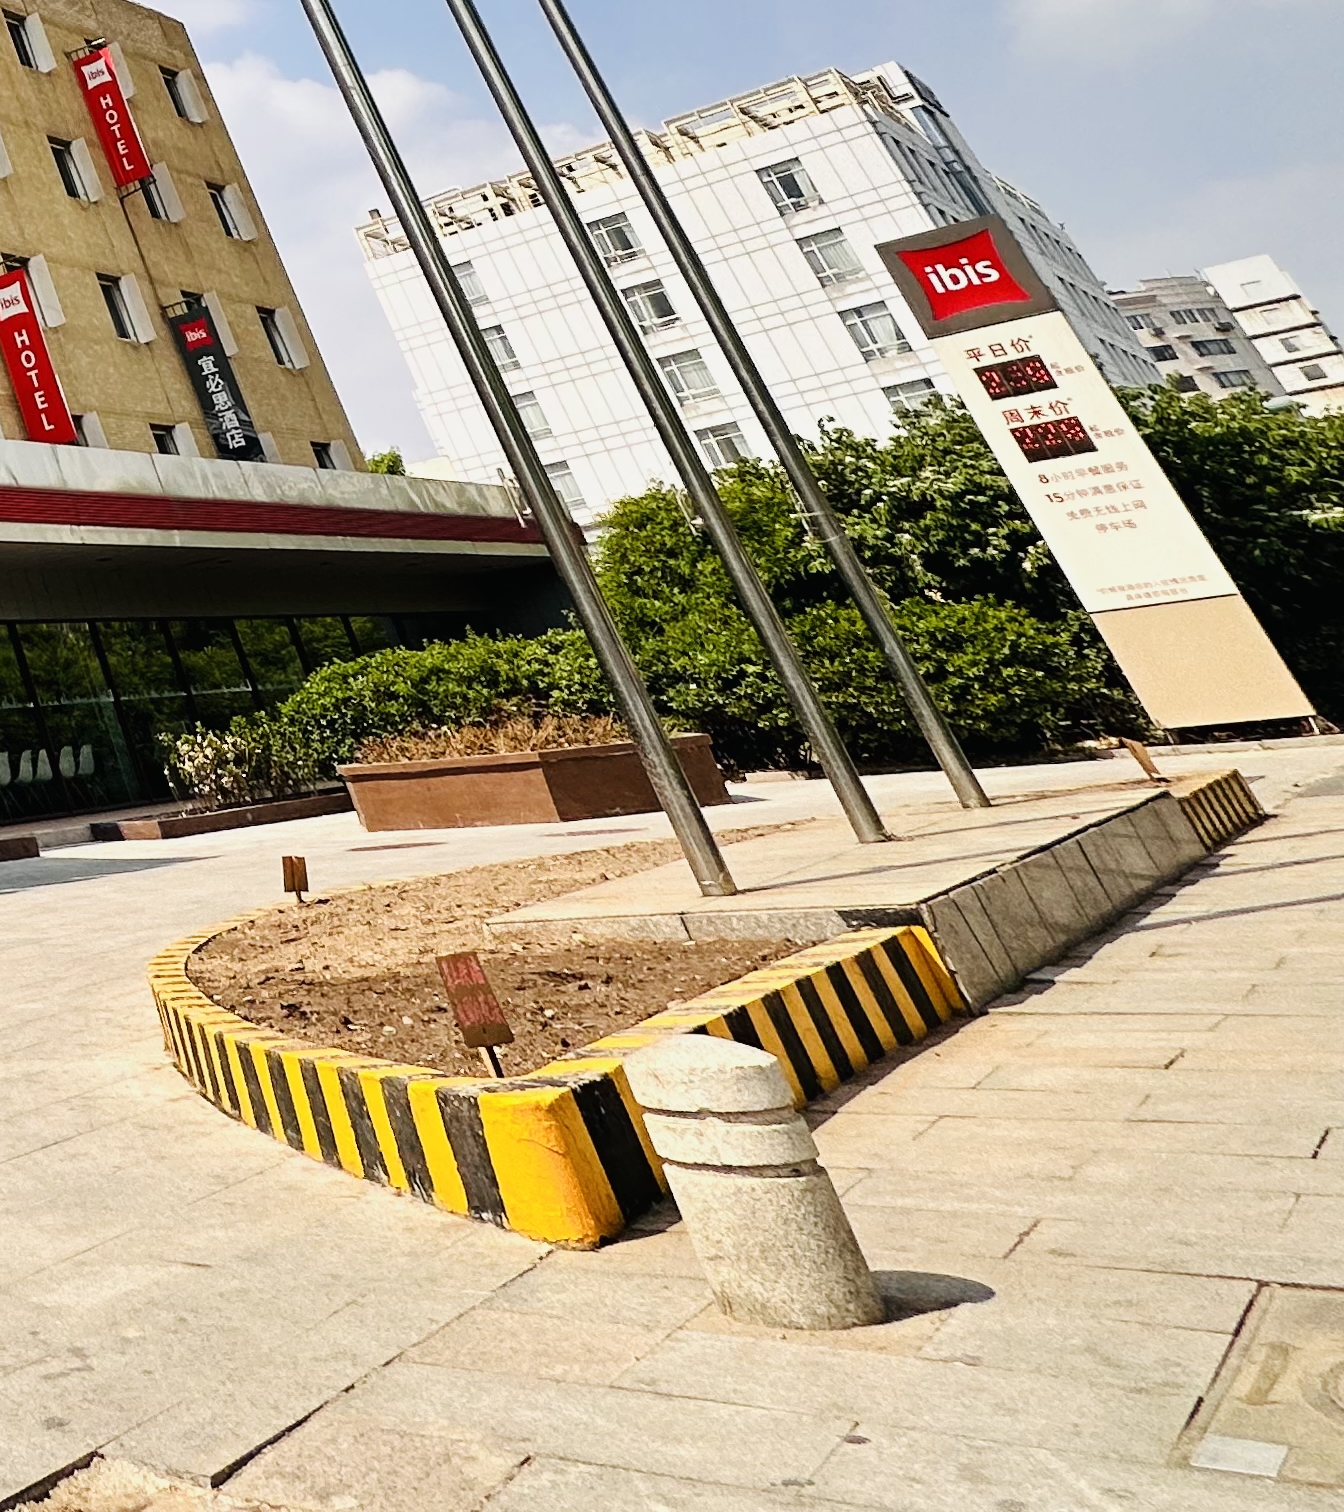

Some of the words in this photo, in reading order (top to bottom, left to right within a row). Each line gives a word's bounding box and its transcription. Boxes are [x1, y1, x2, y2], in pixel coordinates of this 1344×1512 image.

[87, 66, 106, 81] ibis
[99, 93, 134, 171] HOTEL
[0, 295, 21, 311] ibis
[924, 257, 1000, 294] ibis
[13, 328, 55, 431] HOTEL
[197, 355, 247, 450] 宜必思酒店
